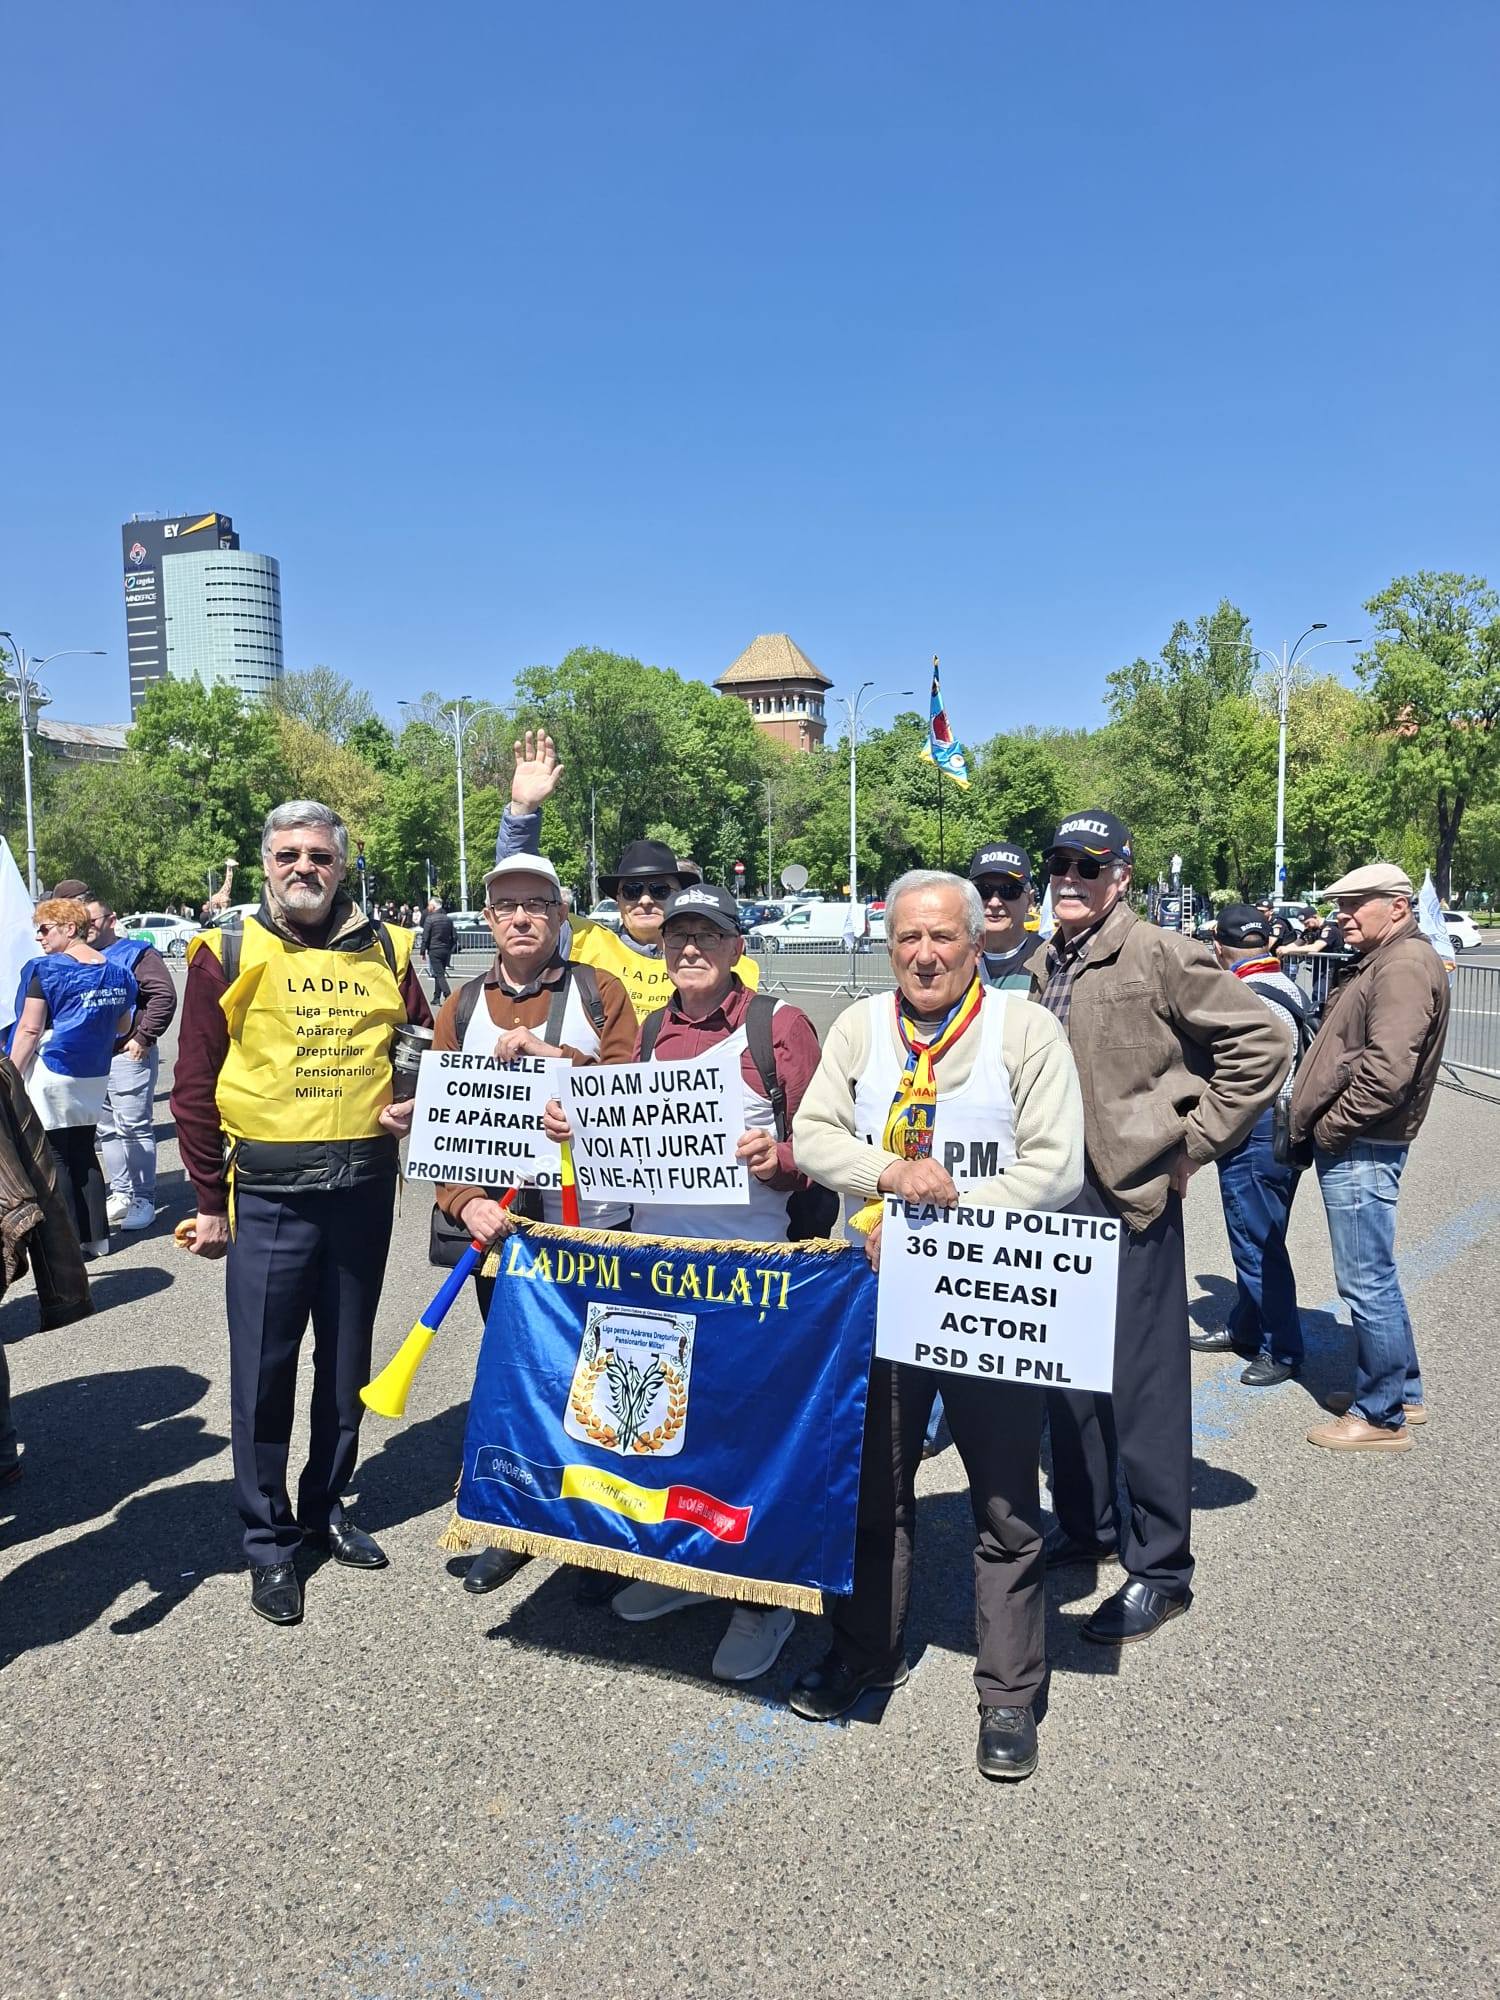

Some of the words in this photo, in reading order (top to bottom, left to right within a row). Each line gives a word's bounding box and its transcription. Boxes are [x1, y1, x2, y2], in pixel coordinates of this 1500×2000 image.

[164, 523, 180, 538] EY
[1058, 819, 1110, 837] ROMIL
[980, 851, 1022, 866] ROMIL
[623, 966, 670, 984] LADP
[296, 1006, 321, 1018] Liga
[328, 1007, 368, 1018] pentru
[296, 1025, 353, 1038] Apărarea
[296, 1045, 365, 1058] Drepturilor
[295, 1065, 376, 1077] Pensionarilor
[440, 1053, 546, 1074] SERTARELE
[295, 1086, 343, 1098] Militari
[446, 1081, 531, 1102] COMISIEI
[570, 1074, 606, 1097] NOI
[611, 1073, 642, 1096] AM
[649, 1067, 724, 1093] JURAT,
[428, 1107, 451, 1123] DE
[455, 1108, 545, 1130] APĂRARE
[576, 1105, 627, 1128] V-AM
[632, 1097, 723, 1126] APĂRAT.
[434, 1135, 536, 1159] CIMITIRUL
[581, 1137, 615, 1158] VOI
[620, 1136, 651, 1165] AȚI
[657, 1133, 727, 1158] JURAT
[578, 1166, 597, 1192] ȘI
[600, 1167, 663, 1196] NE-AȚI
[668, 1165, 743, 1189] FURAT.
[887, 1197, 995, 1229] TEATRU
[1005, 1211, 1118, 1241] POLITIC
[906, 1236, 938, 1258] 36
[948, 1241, 984, 1263] DE
[992, 1246, 1042, 1270] ANI
[1053, 1253, 1092, 1275] CU
[505, 1242, 622, 1291] LADPM
[630, 1271, 643, 1279] -
[650, 1260, 792, 1323] GALAȚI
[934, 1275, 1057, 1308] ACEEASI
[602, 1325, 613, 1334] Liga
[614, 1327, 630, 1335] pentru
[653, 1331, 680, 1342] Drepturilor
[940, 1312, 1047, 1344] ACTORI
[615, 1336, 648, 1347] Pensionarilor
[649, 1341, 665, 1350] Militari
[915, 1342, 968, 1369] PSD
[977, 1352, 1005, 1375] SI
[1015, 1357, 1072, 1384] PNL
